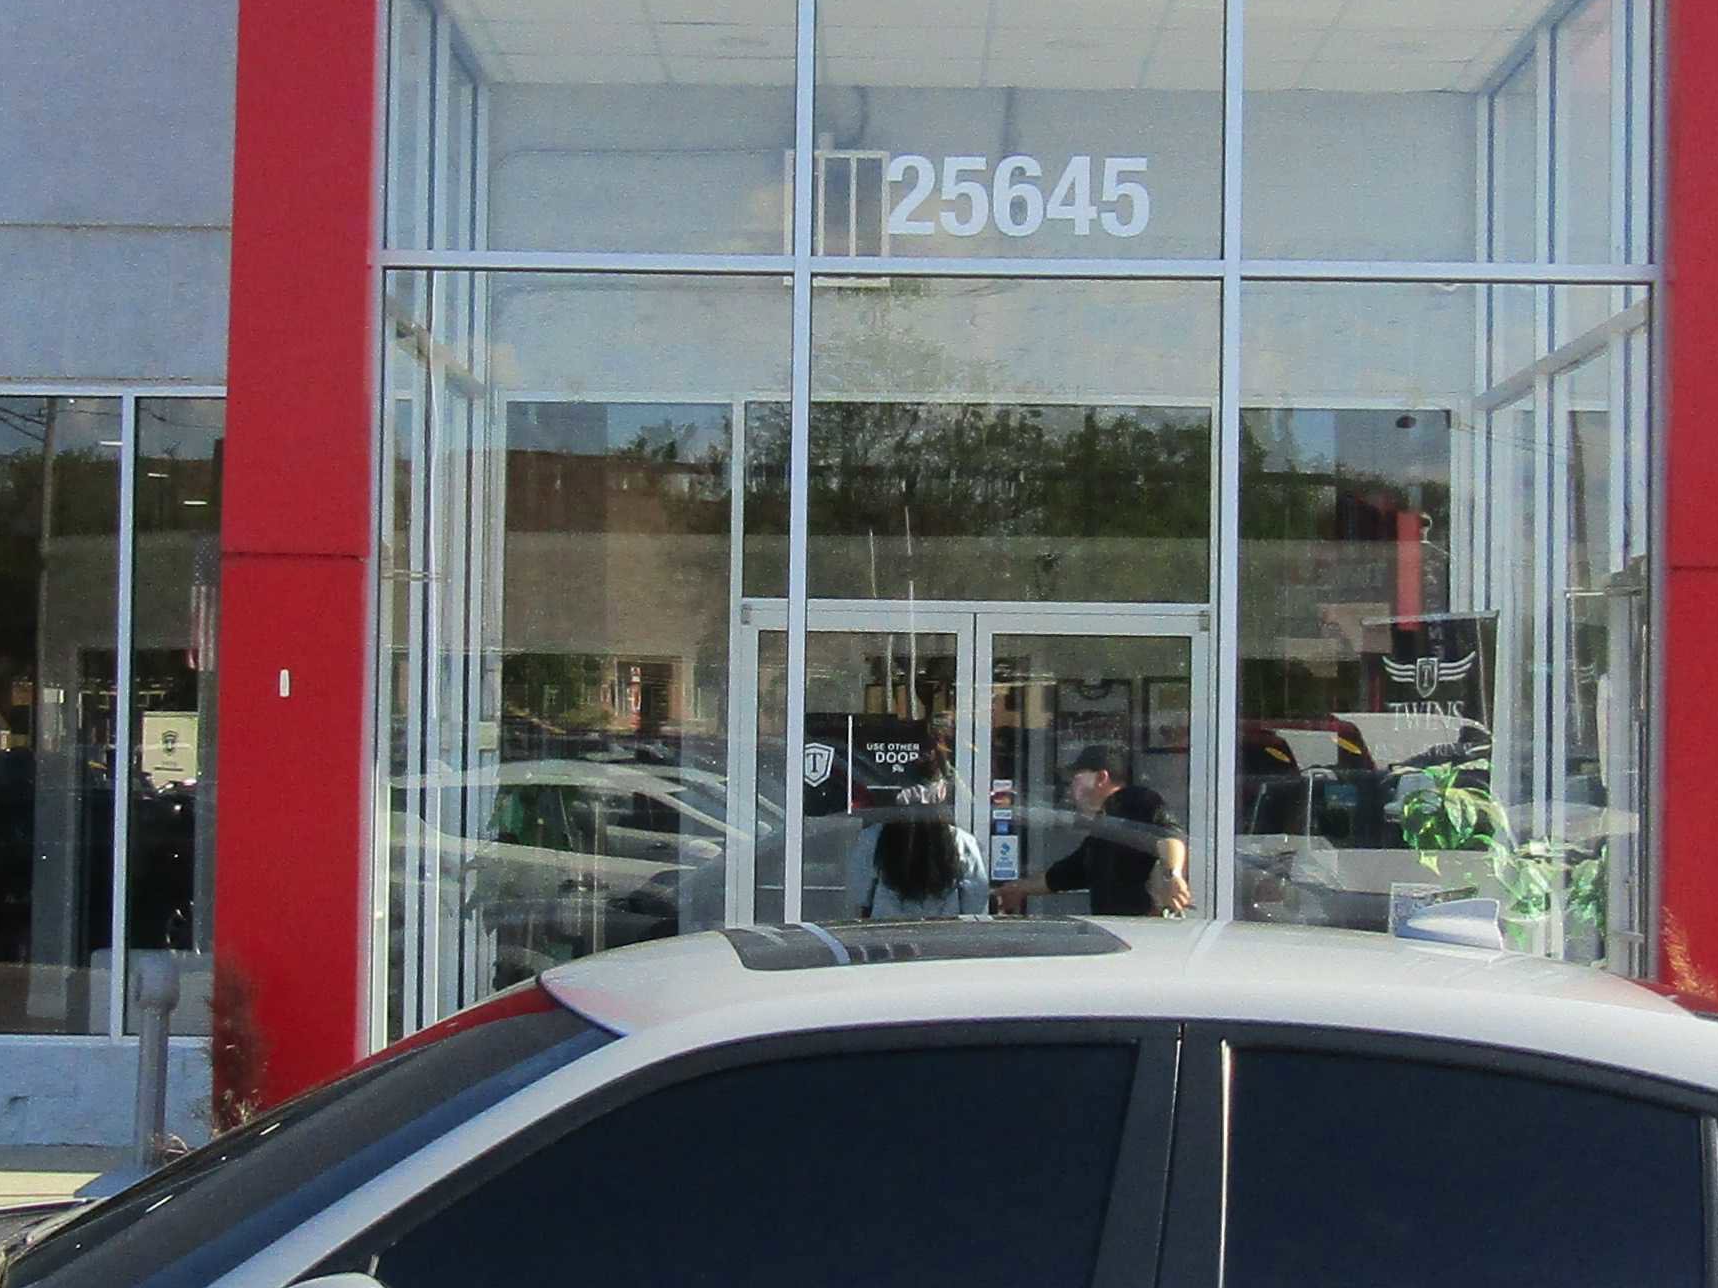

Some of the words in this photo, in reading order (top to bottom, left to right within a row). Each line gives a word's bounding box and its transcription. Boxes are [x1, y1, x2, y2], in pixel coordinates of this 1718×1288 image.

[887, 154, 1151, 238] 25645
[866, 743, 884, 751] USE
[888, 743, 920, 751] OTHER
